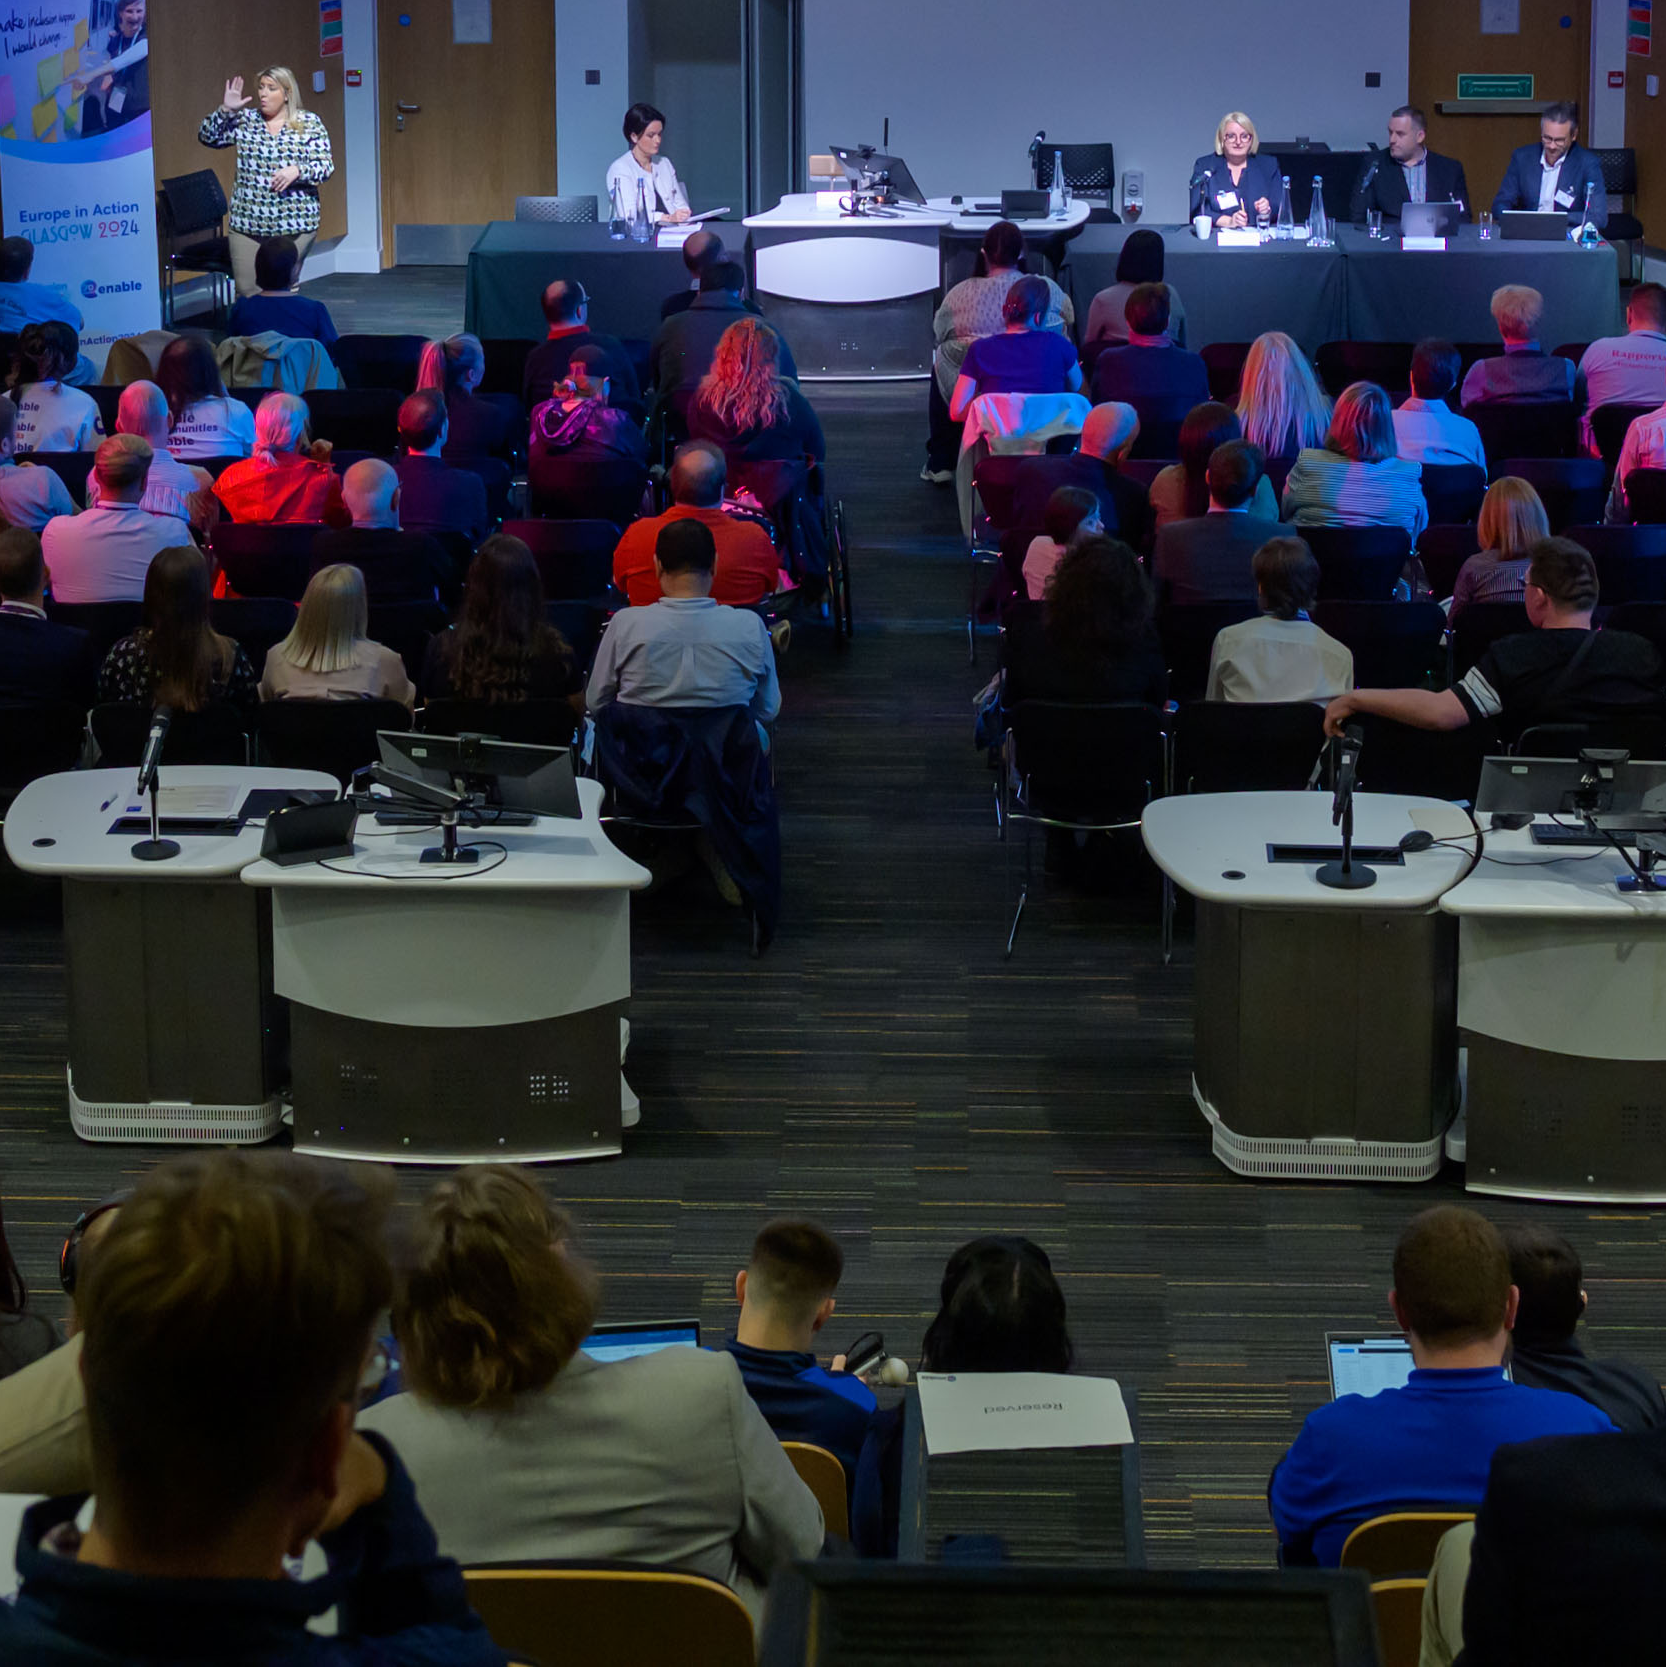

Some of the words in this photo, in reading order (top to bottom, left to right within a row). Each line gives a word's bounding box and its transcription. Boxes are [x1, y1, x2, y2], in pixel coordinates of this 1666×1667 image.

[12, 30, 38, 56] would
[19, 207, 71, 227] Europe
[74, 204, 89, 218] in
[91, 201, 140, 217] Action
[98, 219, 140, 239] 2024
[98, 280, 142, 295] enable
